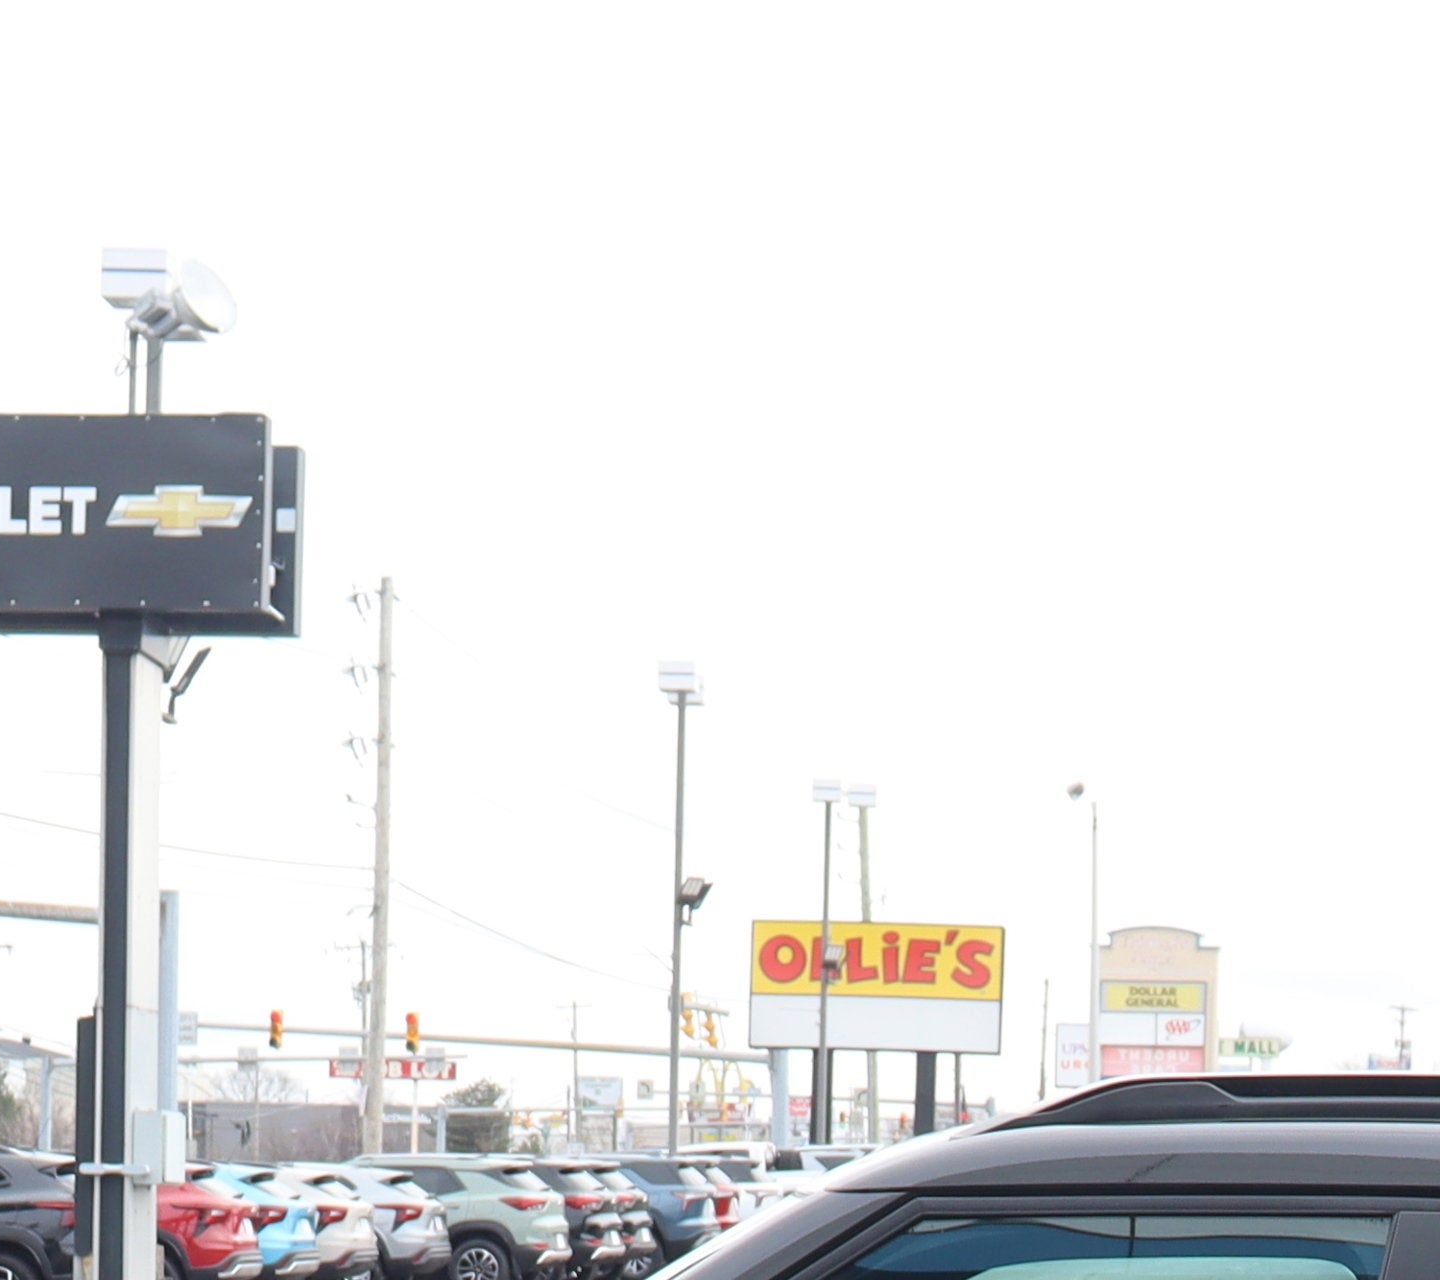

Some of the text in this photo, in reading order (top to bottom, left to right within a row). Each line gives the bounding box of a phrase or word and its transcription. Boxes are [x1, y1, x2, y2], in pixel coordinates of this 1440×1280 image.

[1129, 986, 1177, 997] DOLLAR
[1125, 998, 1180, 1008] GENERAL
[1234, 1041, 1277, 1056] MALL
